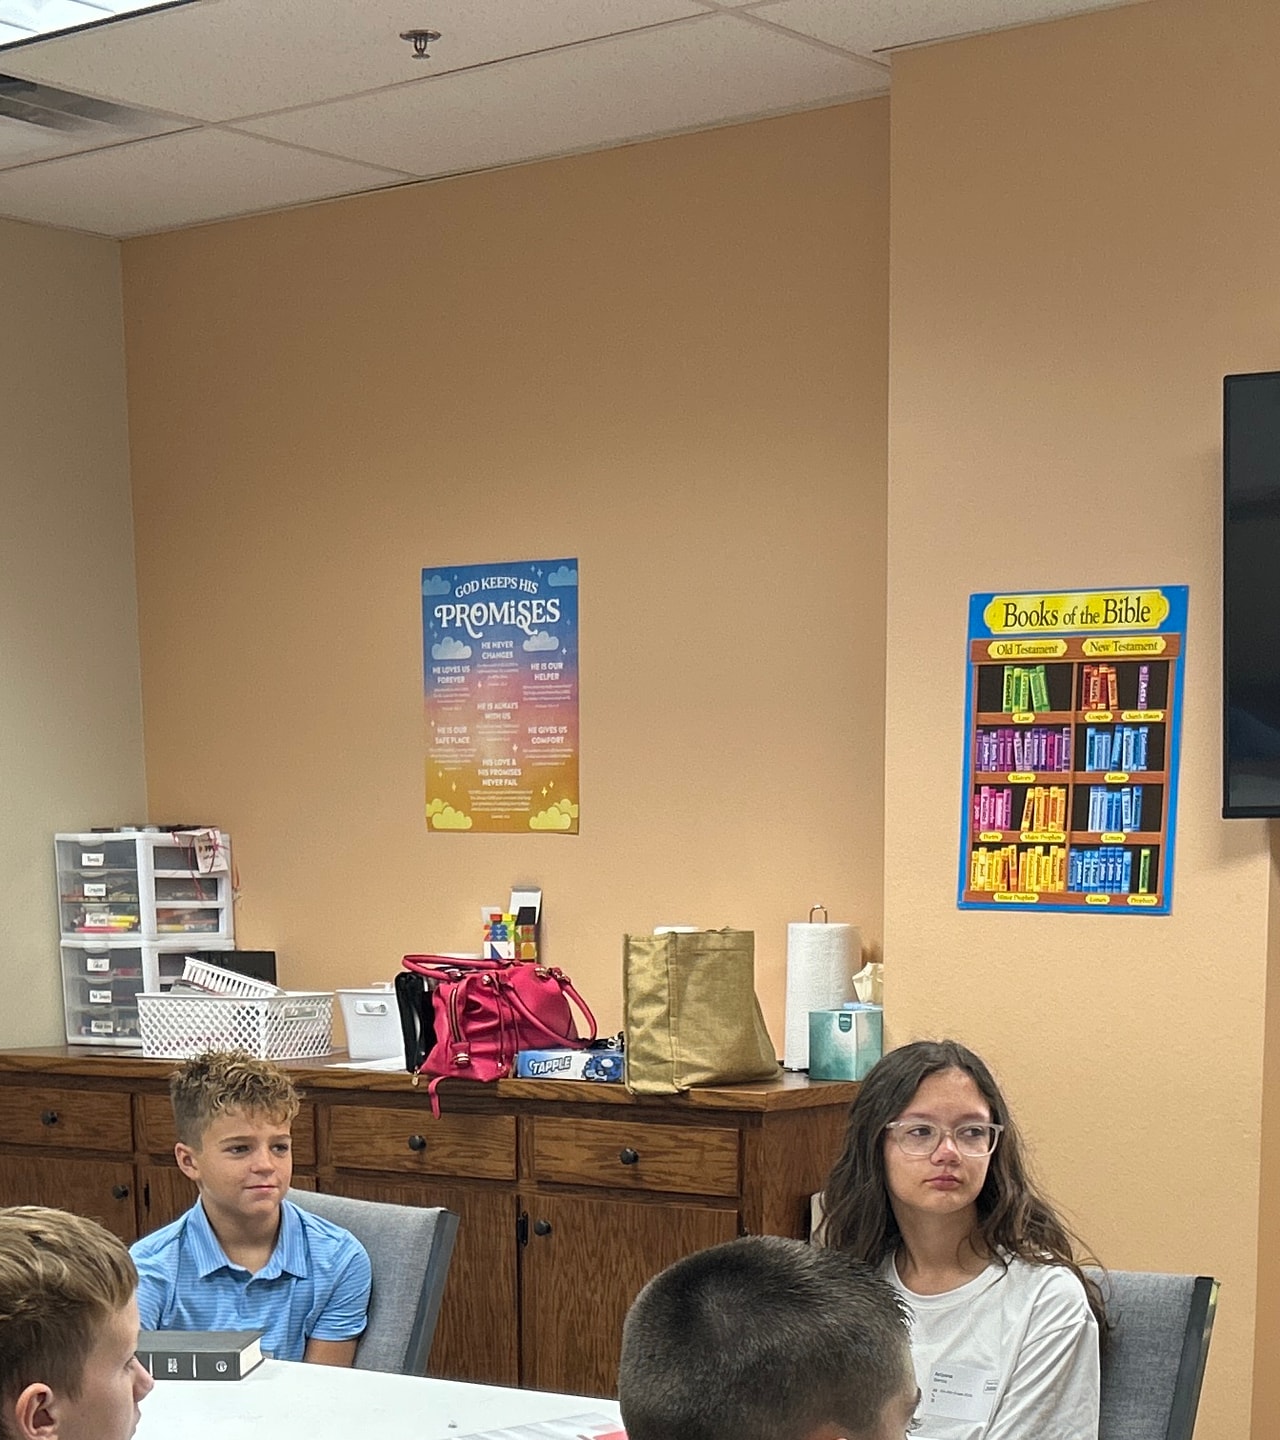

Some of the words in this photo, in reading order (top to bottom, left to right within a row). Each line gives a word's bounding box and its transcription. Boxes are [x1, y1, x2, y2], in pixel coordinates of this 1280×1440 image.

[455, 580, 480, 598] GOD
[481, 576, 518, 590] KEEPS
[519, 579, 539, 594] HIS
[1002, 600, 1059, 628] Books
[1063, 606, 1078, 625] of
[1080, 606, 1100, 624] the
[1102, 596, 1151, 624] Bible
[481, 642, 491, 650] HE
[492, 640, 514, 649] NEVER
[996, 643, 1013, 655] Old
[1015, 642, 1058, 655] Testament
[1090, 641, 1110, 653] New
[1112, 640, 1158, 652] Testament
[481, 651, 514, 660] CHANGES
[461, 665, 470, 673] US
[531, 663, 540, 671] HE
[547, 662, 563, 670] OUR
[437, 676, 465, 684] FOREVER
[534, 673, 559, 681] HELPER
[1140, 681, 1148, 702] Acts
[538, 726, 557, 734] GIVES
[451, 736, 470, 744] PLACE
[531, 736, 564, 745] COMFORT
[490, 768, 521, 776] PROMISES
[482, 778, 502, 786] NEVER
[531, 1056, 572, 1075] TAPPLE
